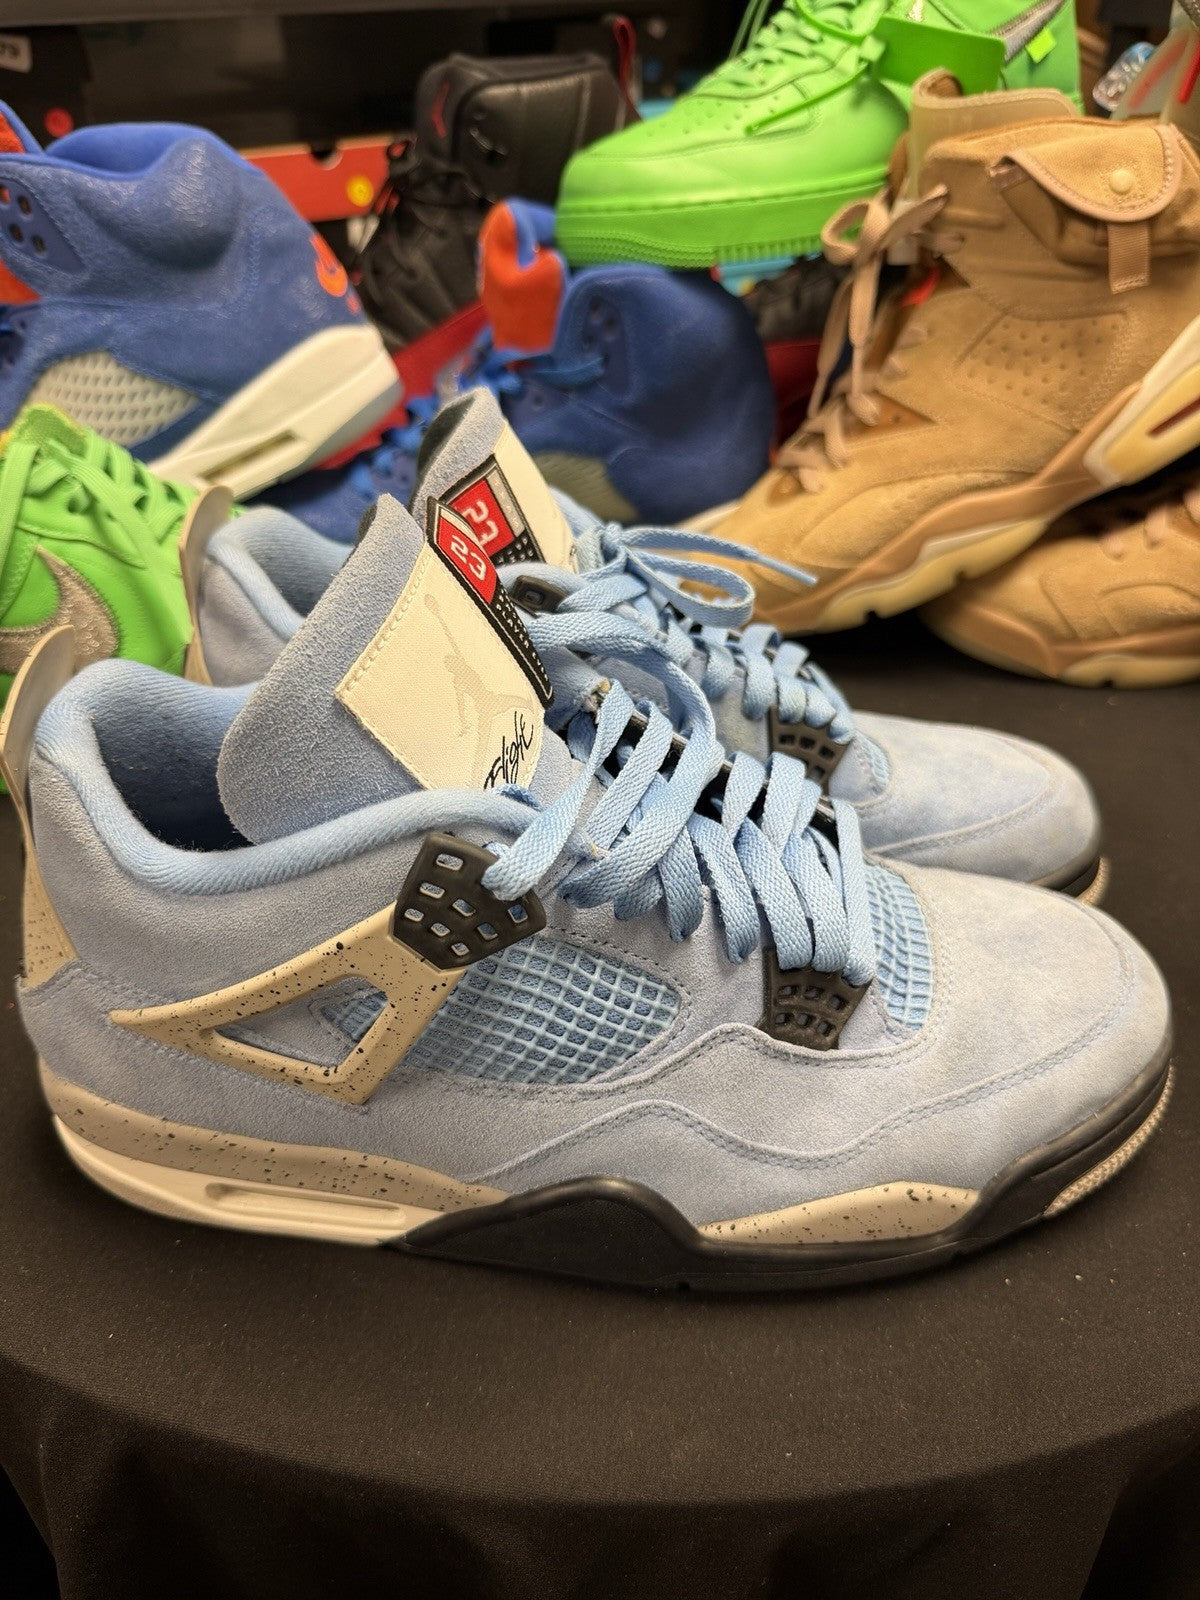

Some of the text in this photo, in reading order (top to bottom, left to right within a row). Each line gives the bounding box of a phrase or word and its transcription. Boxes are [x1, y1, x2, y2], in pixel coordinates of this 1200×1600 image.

[461, 500, 499, 546] 23
[450, 535, 486, 581] 23
[483, 711, 534, 789] Flight
